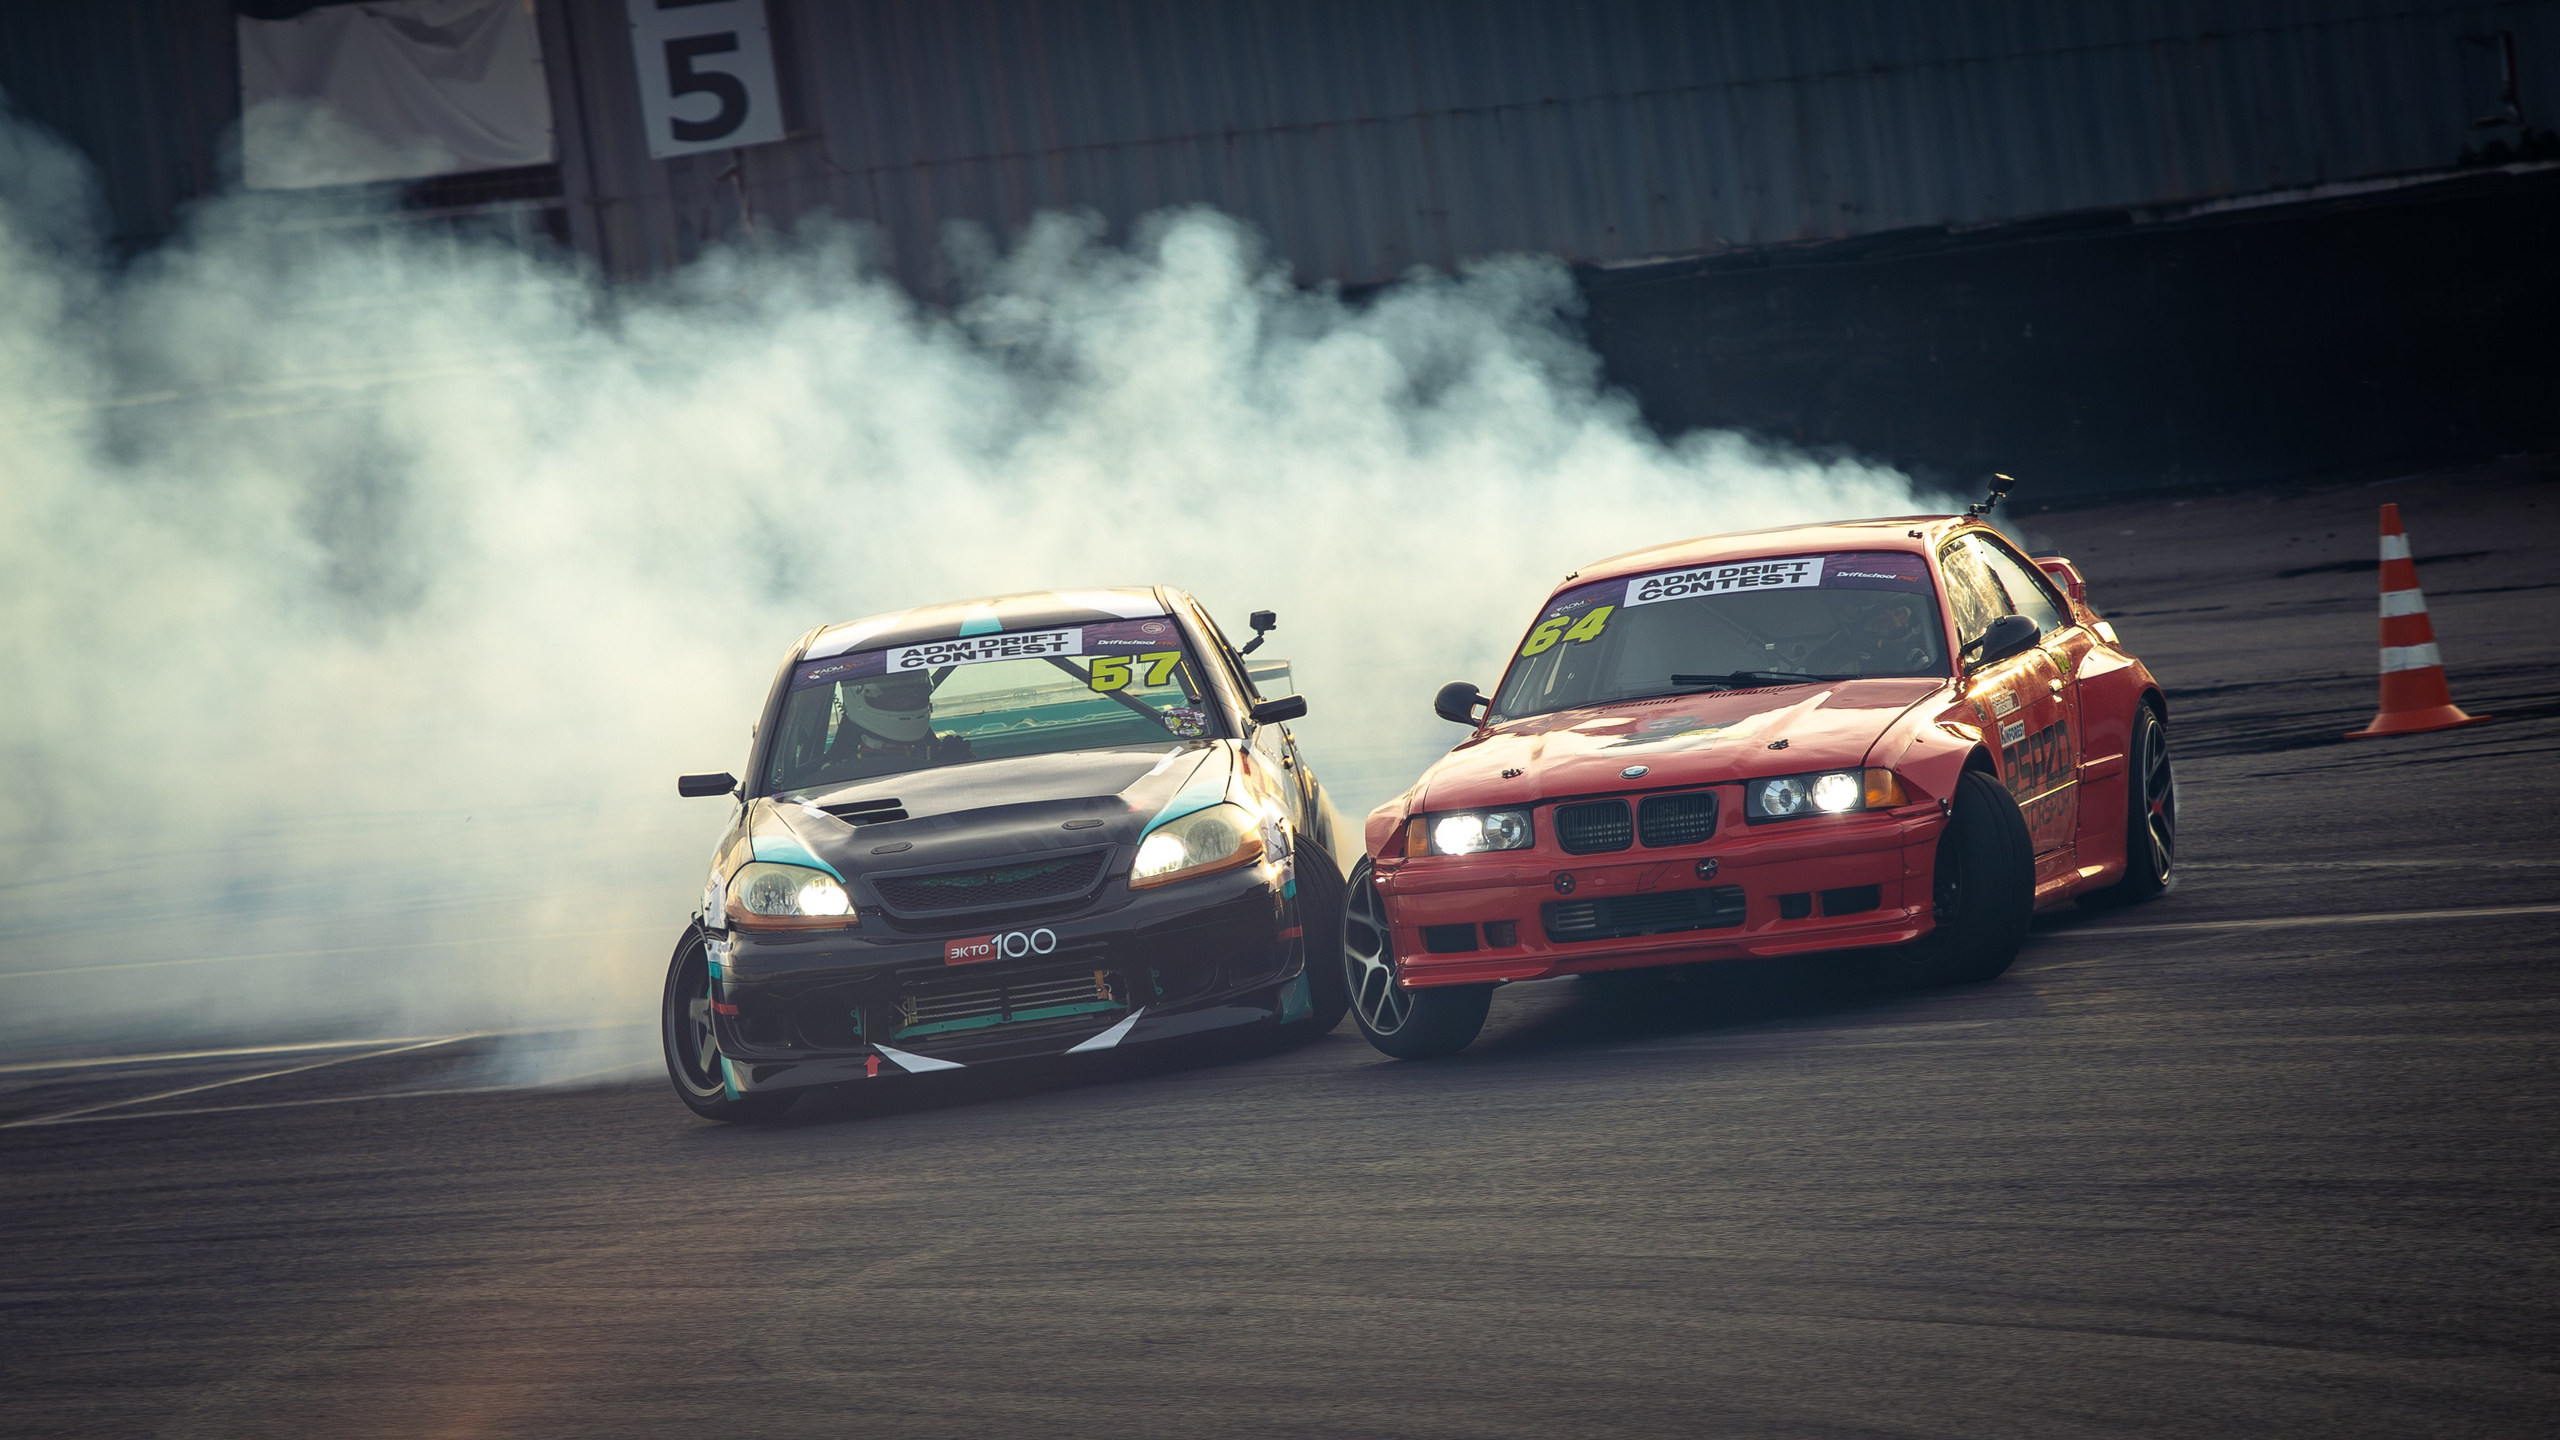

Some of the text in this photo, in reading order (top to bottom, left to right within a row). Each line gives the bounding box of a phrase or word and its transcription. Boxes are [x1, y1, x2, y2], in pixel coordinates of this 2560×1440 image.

[664, 31, 749, 142] 5
[1637, 572, 1808, 601] CONTEST
[1640, 562, 1810, 590] ADM DRIFT
[1837, 571, 1897, 579] Driftschool
[901, 632, 1069, 659] ADM DRIFT
[1520, 605, 1616, 658] 64
[900, 641, 1069, 668] CONTEST
[1088, 650, 1182, 693] 57
[950, 928, 1057, 960] ЭКТО 100
